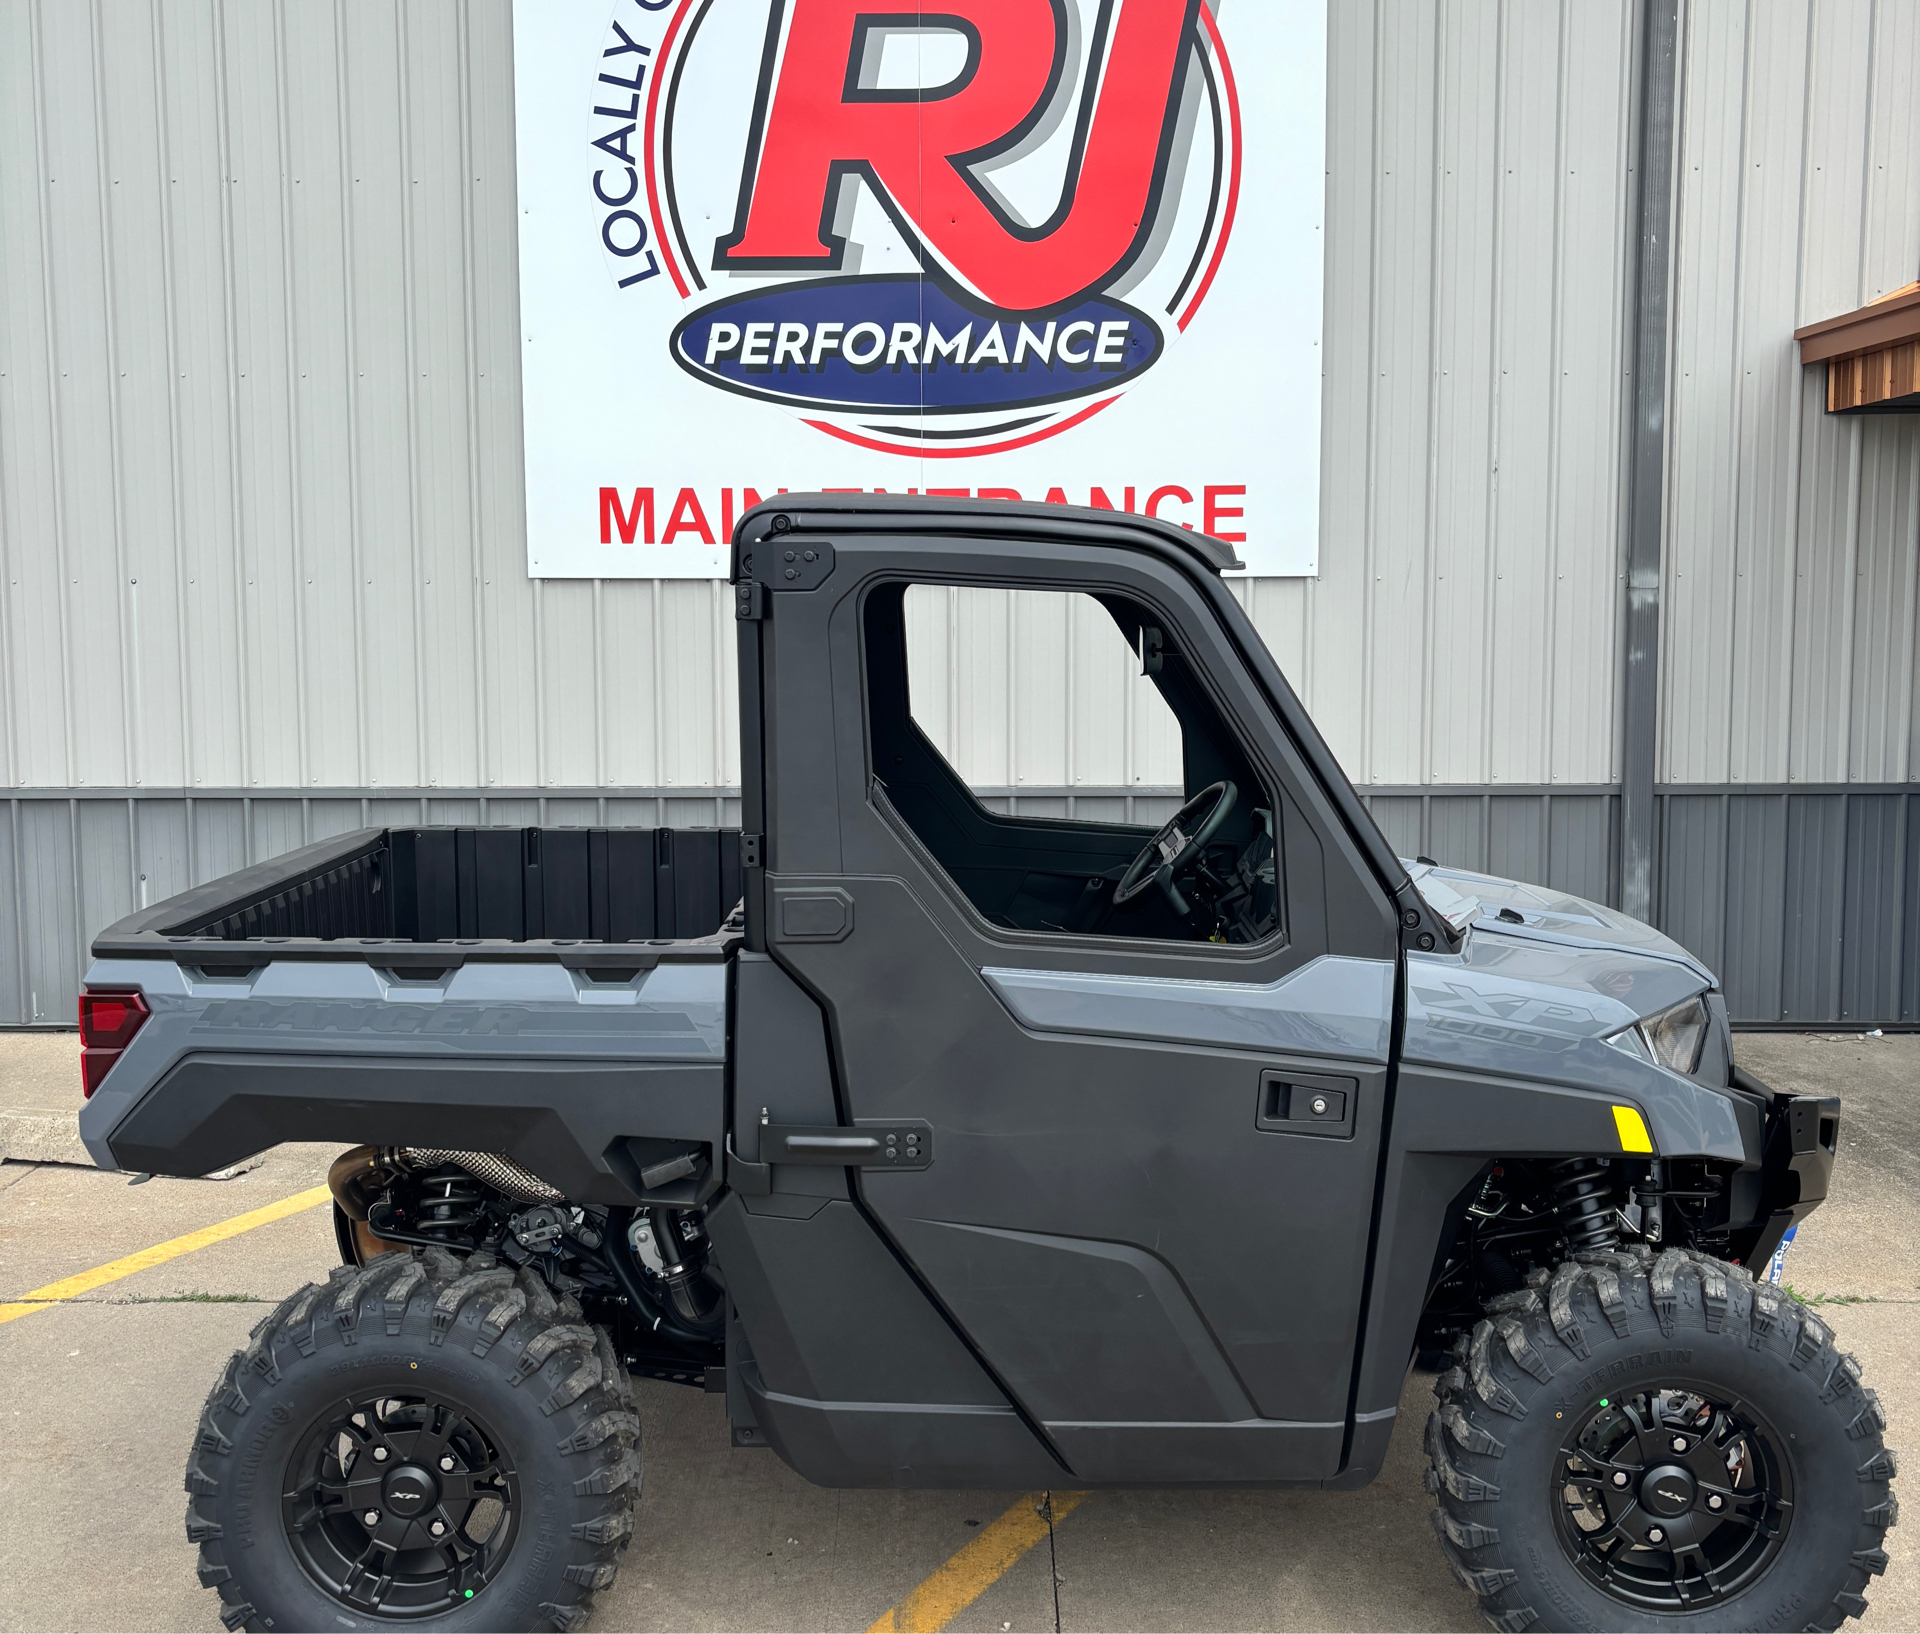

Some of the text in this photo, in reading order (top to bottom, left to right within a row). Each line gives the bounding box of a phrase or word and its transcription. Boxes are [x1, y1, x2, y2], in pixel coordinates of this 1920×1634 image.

[591, 19, 661, 289] LOCALLY
[705, 321, 1130, 366] PERFORMANCE
[599, 487, 788, 544] MAI
[209, 1000, 533, 1036] RANGER
[1424, 981, 1596, 1023] XP
[1427, 1014, 1545, 1046] 1000
[1552, 1348, 1694, 1414] X-TERRAIN
[234, 1420, 278, 1550] PRO ARMOR
[389, 1491, 421, 1501] XP
[504, 1479, 557, 1618] X-TERRAIN
